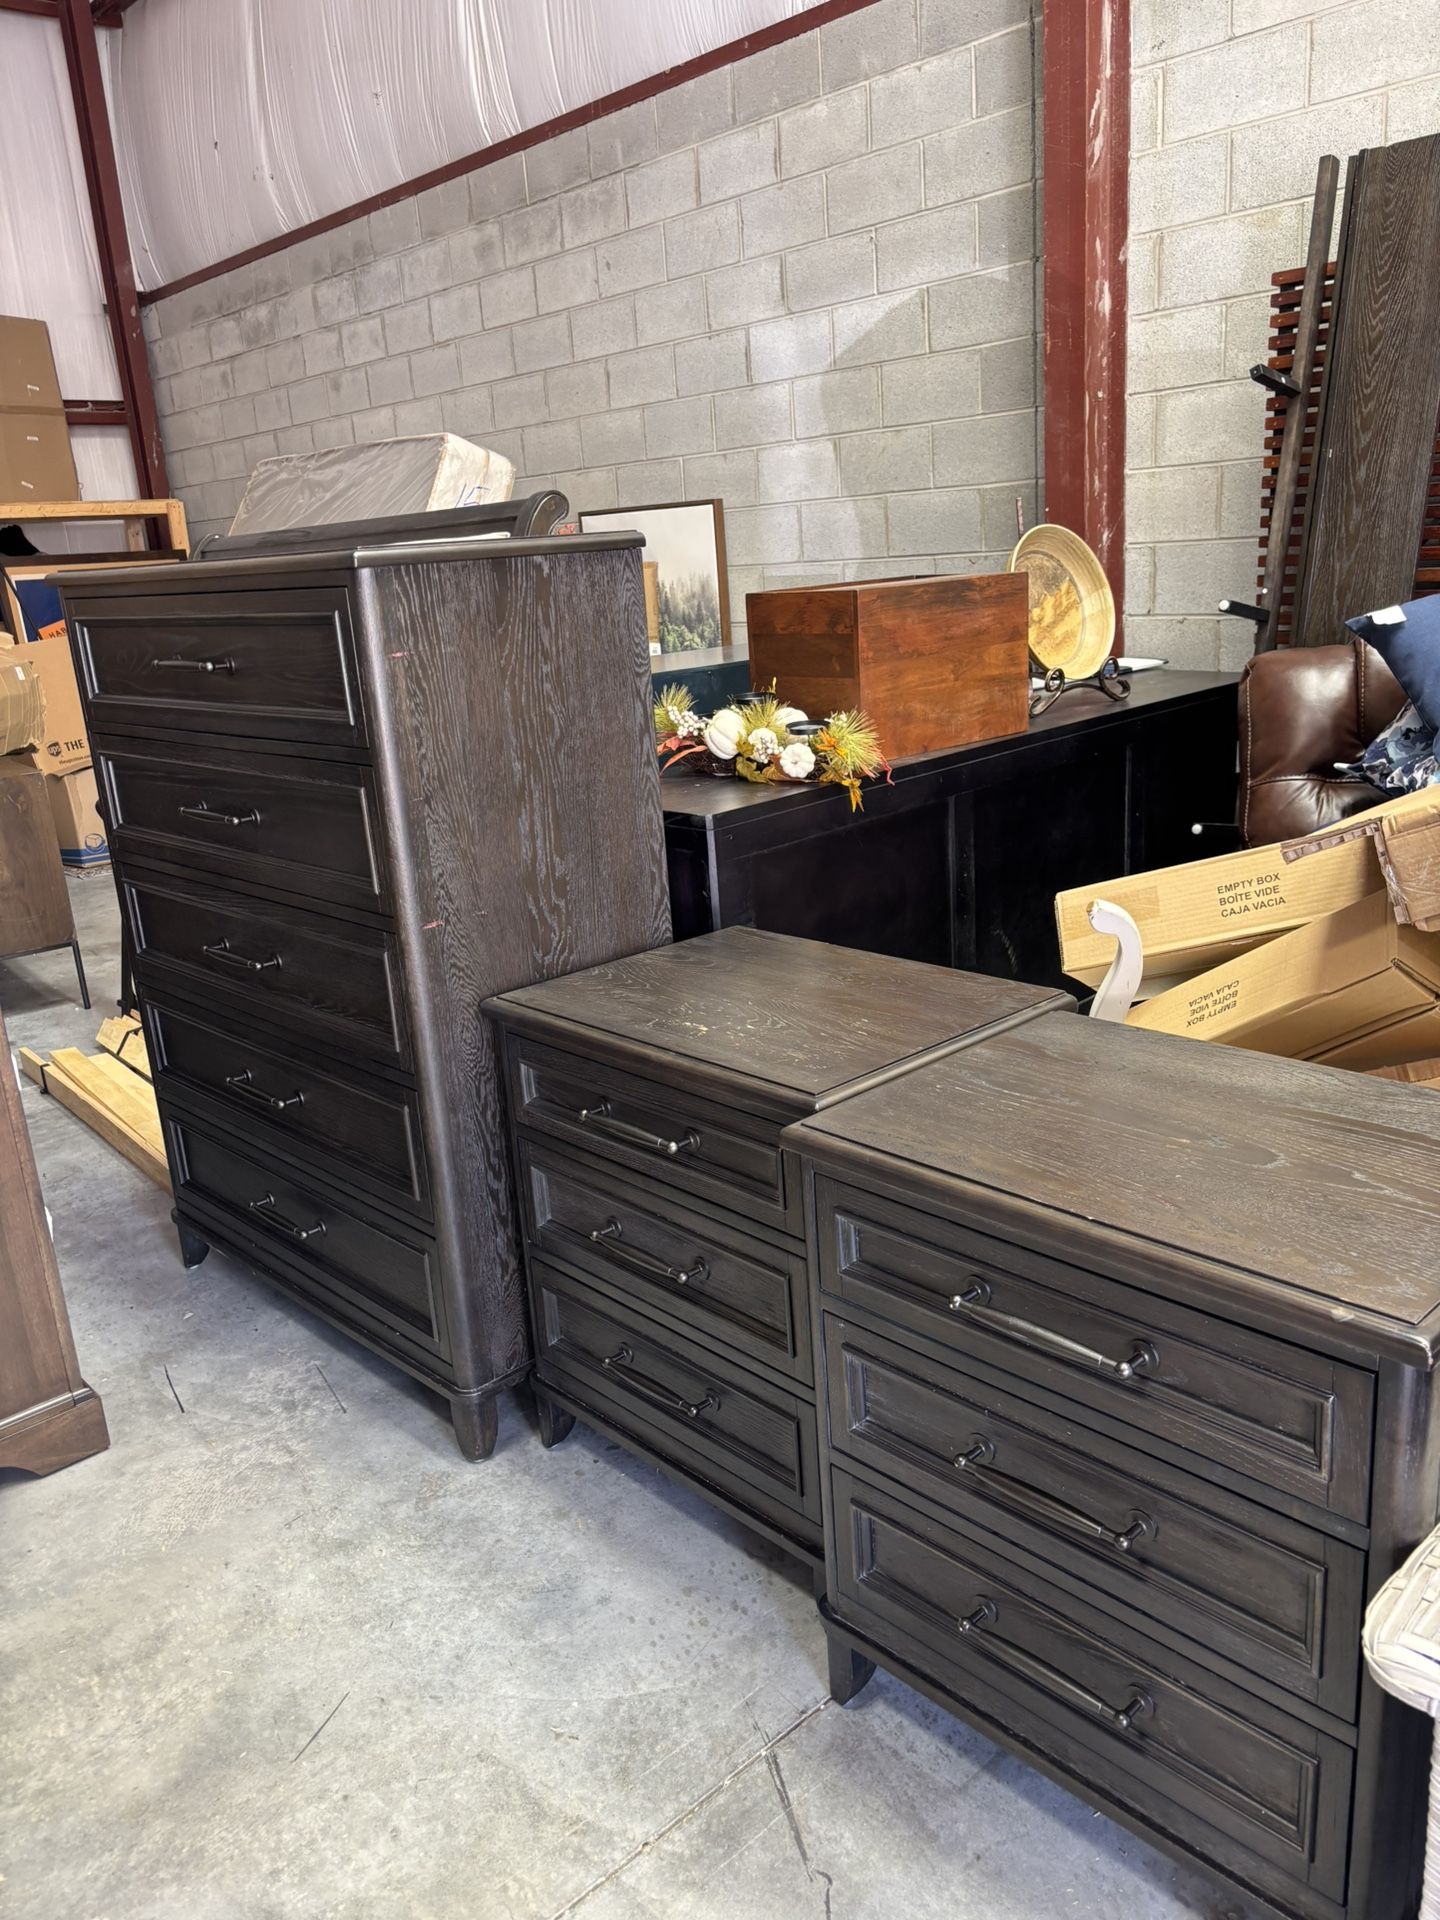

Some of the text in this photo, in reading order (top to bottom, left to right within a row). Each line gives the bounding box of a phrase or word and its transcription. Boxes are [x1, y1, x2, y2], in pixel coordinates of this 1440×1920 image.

[64, 739, 85, 751] THE
[1217, 872, 1281, 894] EMPTY BOX
[1254, 885, 1280, 897] VIDE
[1221, 896, 1286, 917] CAJA VACIA
[1188, 980, 1239, 1007] CAJA VACIA
[1186, 1000, 1237, 1028] EMPTY BOX
[1190, 1003, 1209, 1017] VIDE
